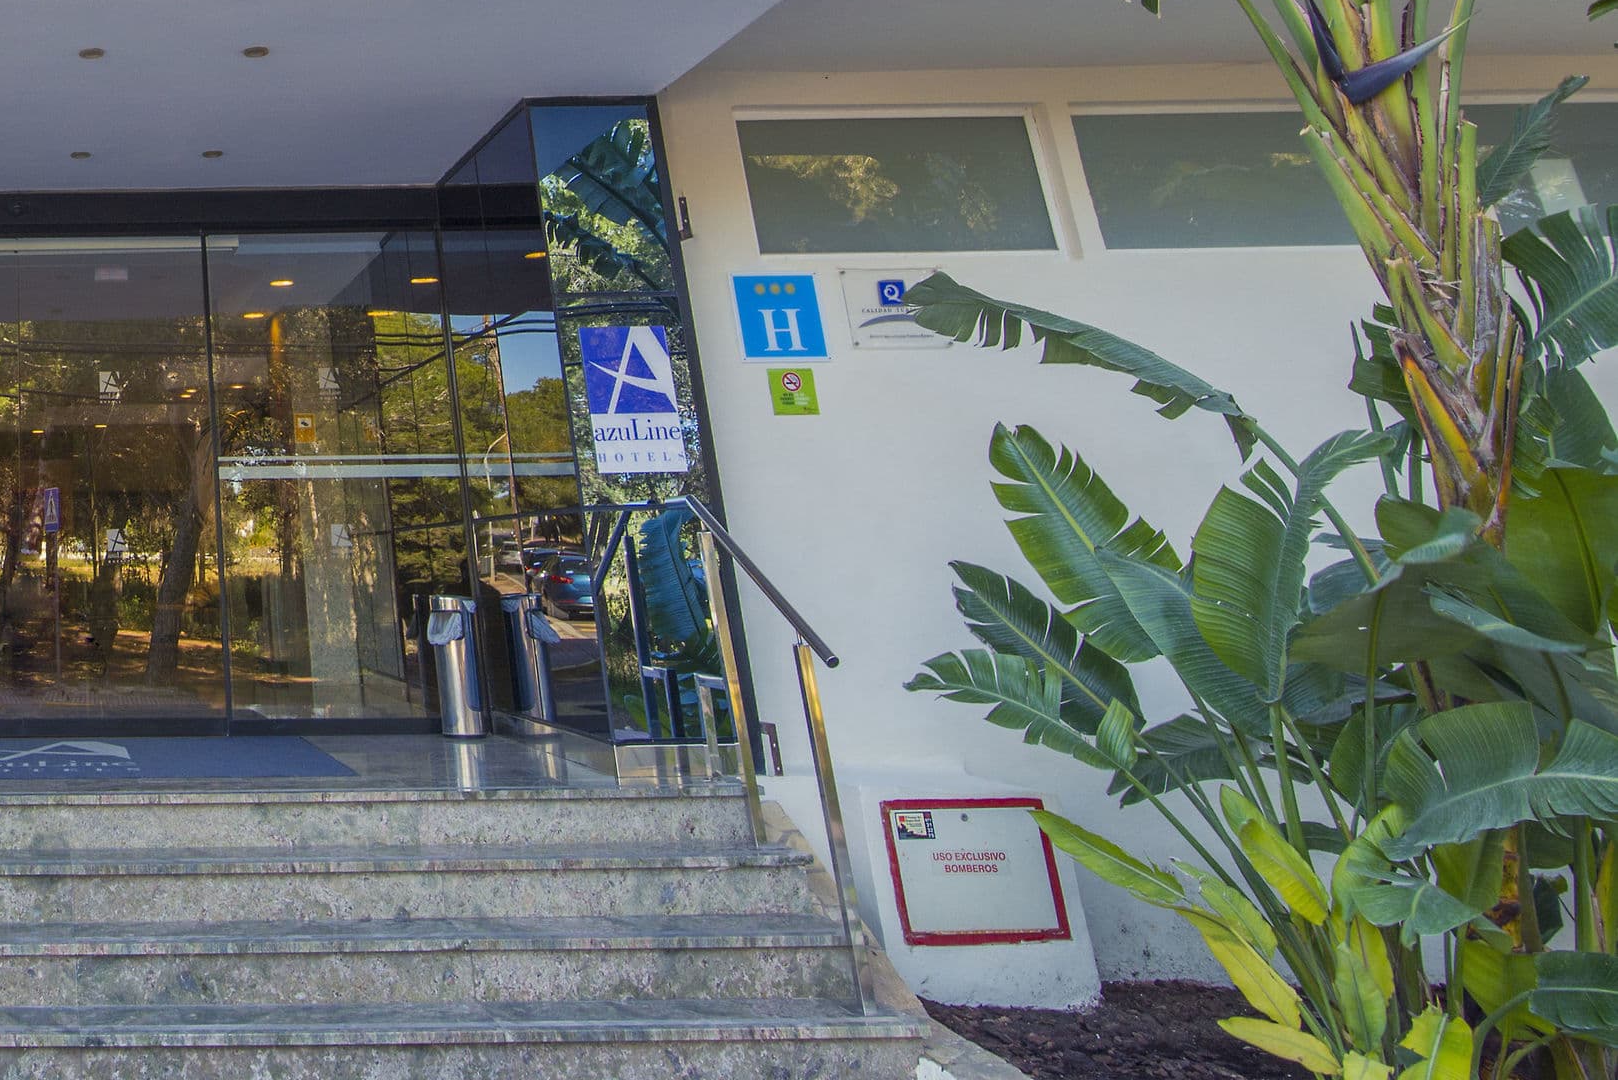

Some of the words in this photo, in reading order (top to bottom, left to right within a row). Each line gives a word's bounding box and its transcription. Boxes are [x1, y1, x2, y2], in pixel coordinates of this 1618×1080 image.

[758, 308, 808, 352] H
[595, 419, 681, 442] azuLine
[598, 451, 686, 463] HOTELS
[932, 852, 952, 861] USO
[955, 852, 1006, 861] EXCLUSIVO
[944, 864, 998, 873] BOMBEROS
